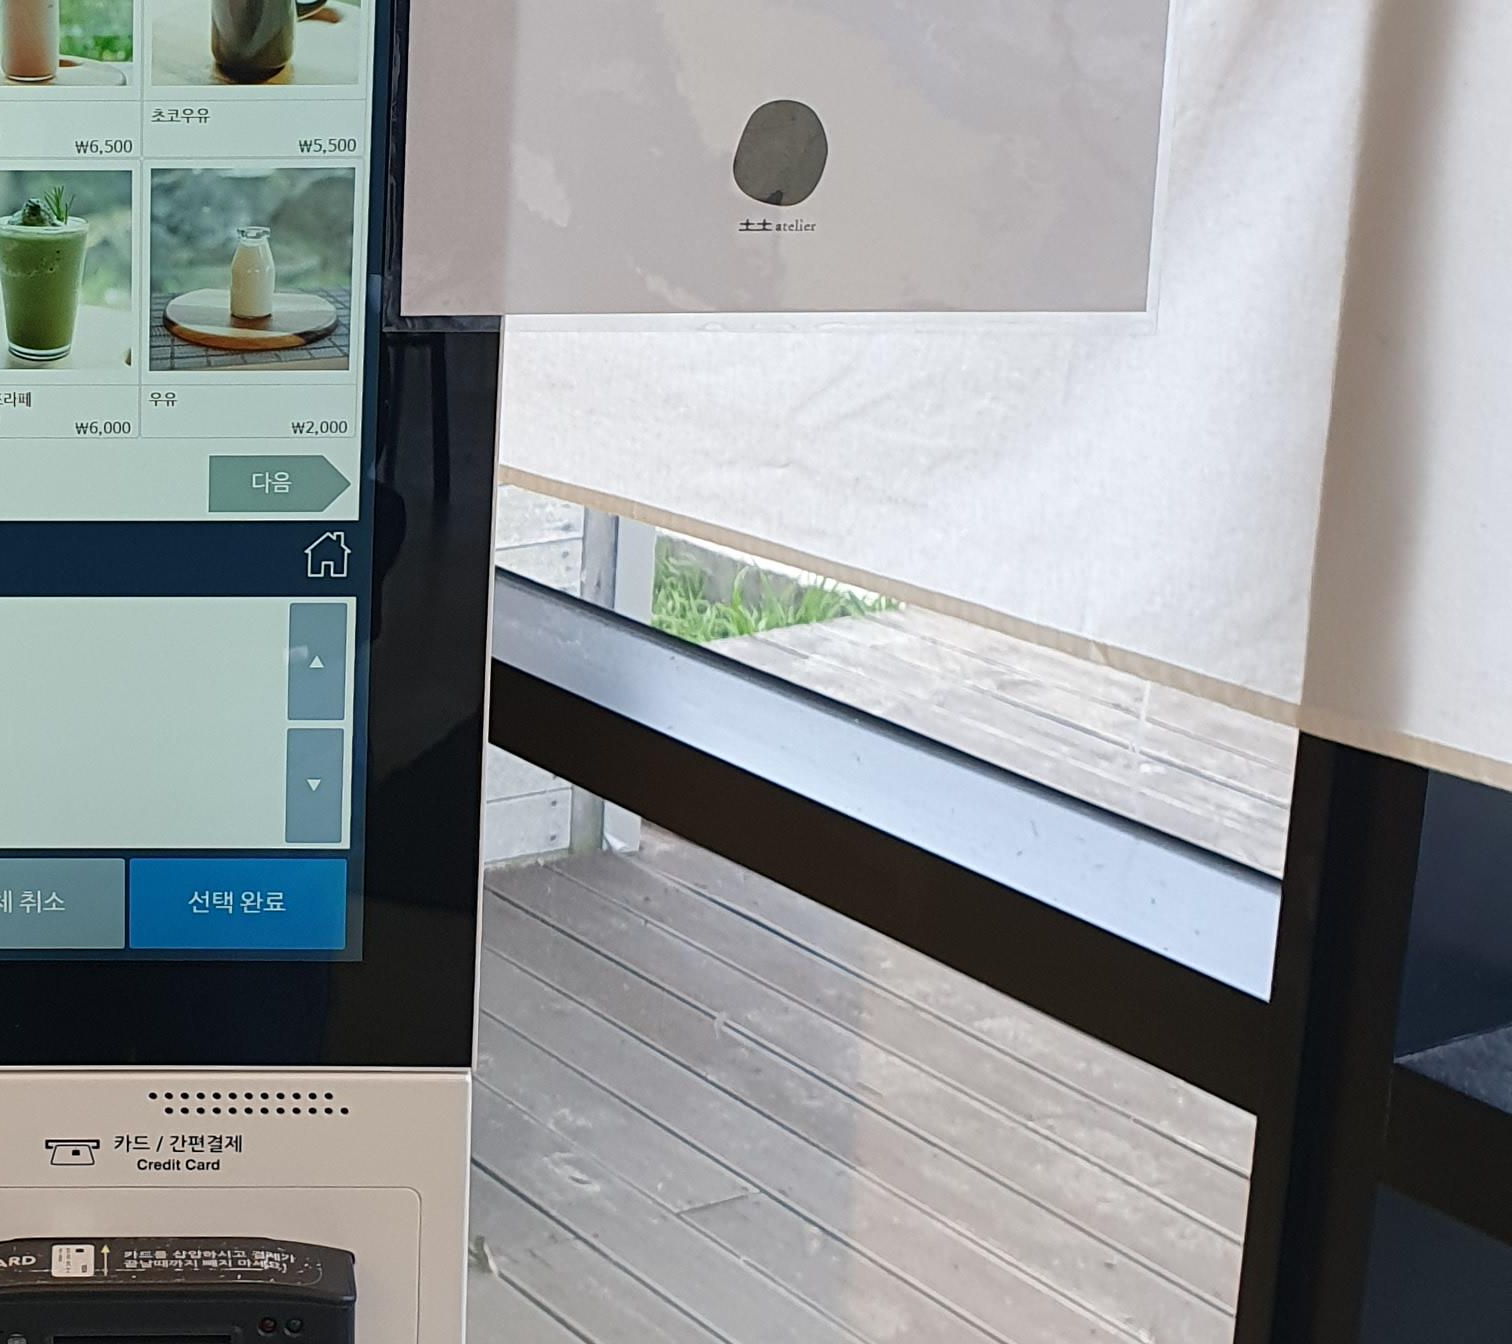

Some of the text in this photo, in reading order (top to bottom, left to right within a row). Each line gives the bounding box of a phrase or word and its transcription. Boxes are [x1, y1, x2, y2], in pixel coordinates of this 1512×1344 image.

[152, 108, 210, 123] 초코우유
[776, 219, 816, 231] atelier
[149, 392, 177, 406] 우유
[253, 472, 291, 493] 다음
[20, 890, 65, 913] 취소
[189, 891, 286, 913] 선택 완료
[115, 1135, 150, 1152] 카드
[170, 1135, 242, 1152] 간편결제
[137, 1159, 220, 1170] Credit Card
